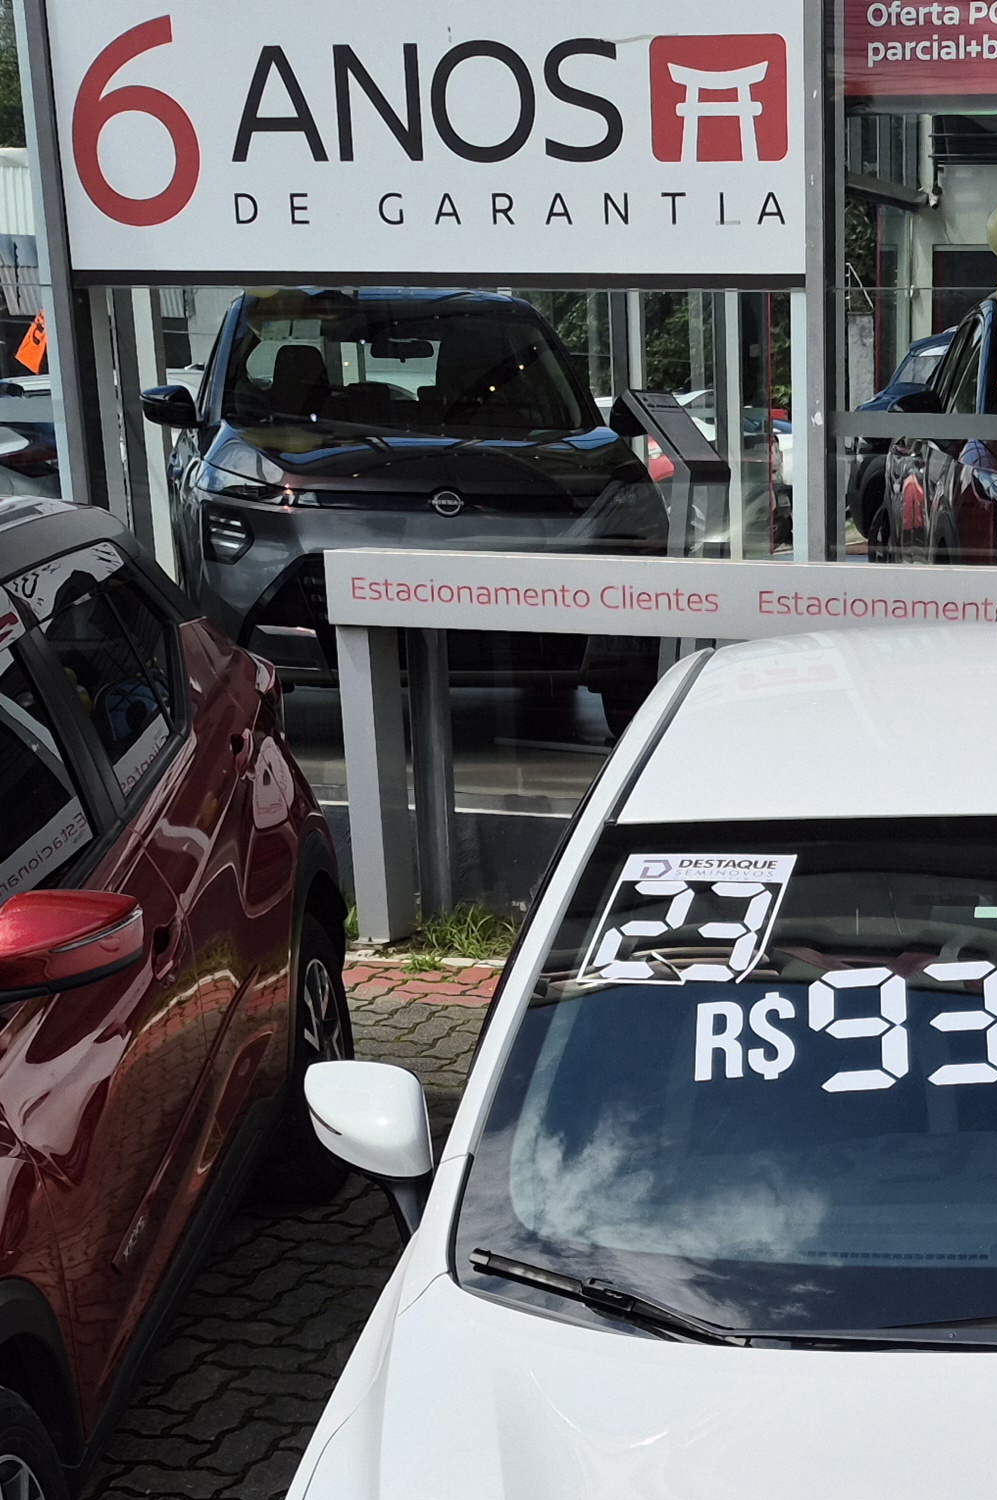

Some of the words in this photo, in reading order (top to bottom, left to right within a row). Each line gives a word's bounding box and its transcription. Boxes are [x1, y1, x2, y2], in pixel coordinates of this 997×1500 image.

[867, 1, 960, 27] Oferta
[73, 14, 201, 227] 6
[231, 38, 624, 163] ANOS
[233, 192, 310, 225] DE
[377, 191, 787, 226] GARANTIA
[351, 576, 591, 609] Estacionamento
[600, 585, 720, 613] Clientes
[675, 869, 773, 878] SEMINOVOS
[678, 859, 778, 870] DESTAQUE
[593, 881, 772, 982] 23
[694, 991, 796, 1082] R$
